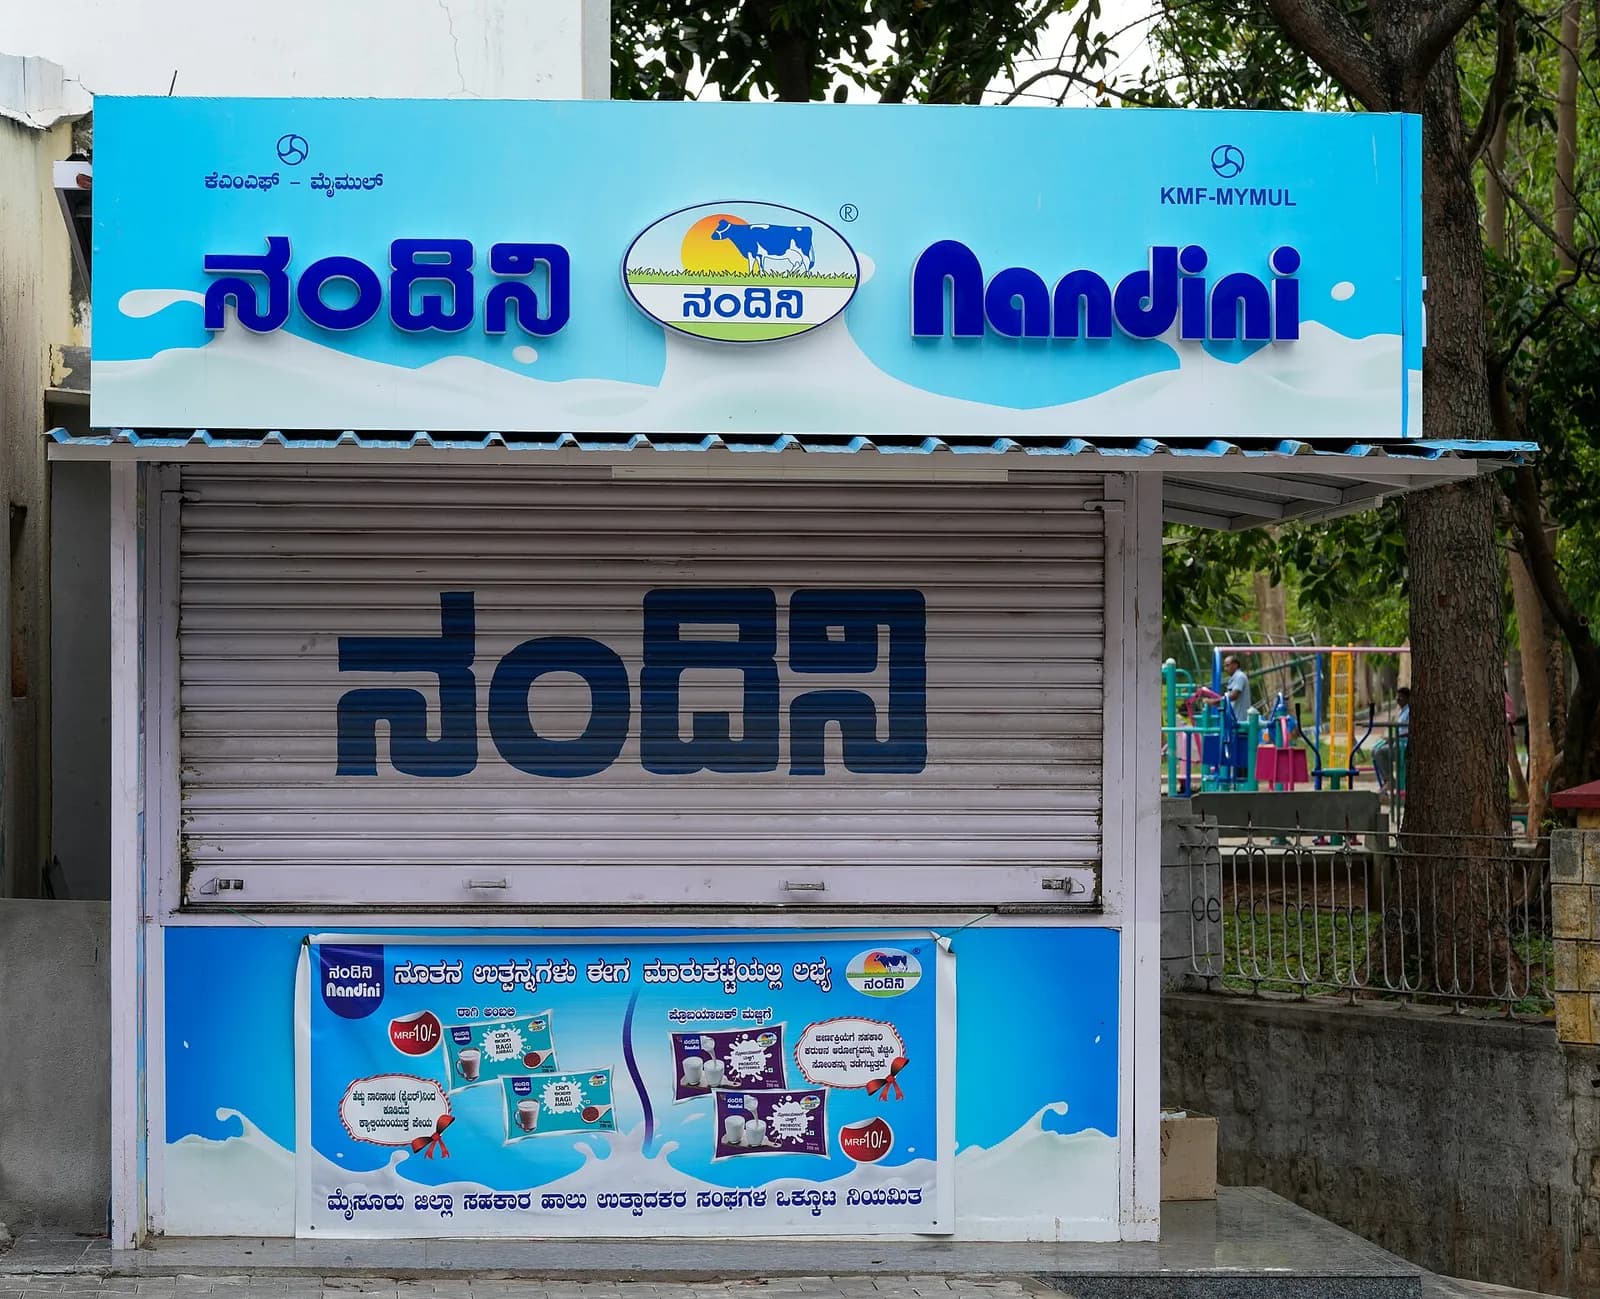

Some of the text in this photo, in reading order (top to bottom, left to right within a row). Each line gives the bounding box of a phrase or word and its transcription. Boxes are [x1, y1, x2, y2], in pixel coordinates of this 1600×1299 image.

[204, 171, 280, 192] ಕೆಎಂಎಫ್
[310, 171, 384, 197] ಮೈಮುಲ್
[1160, 187, 1297, 207] KMF-MYMUL
[203, 236, 572, 338] ನಂದಿನಿ
[910, 239, 1301, 342] Nandini
[683, 287, 804, 318] ನಂದಿನಿ
[334, 587, 928, 778] ನಂದಿನಿ
[328, 964, 373, 979] ನಂದಿನಿ
[394, 955, 832, 995] ನೂತನ ಉತ್ಪನ್ನಗಳು ಈಗ ಮಾರುಕಟ್ಟೆಯಲ್ಲಿ ಲಭ್ಯ
[864, 978, 904, 990] ನಂದಿನಿ
[326, 982, 381, 998] Nandini
[456, 1007, 479, 1018] ರಾಗಿ
[327, 1186, 924, 1220] ಮೈಸೂರು ಜಿಲ್ಲಾ ಸಹಕಾರ ಹಾಲು ಉತ್ಪಾದಕರ ಸಂಘಗಳ ಒಕ್ಕೂಟ ನಿಯಮಿತ
